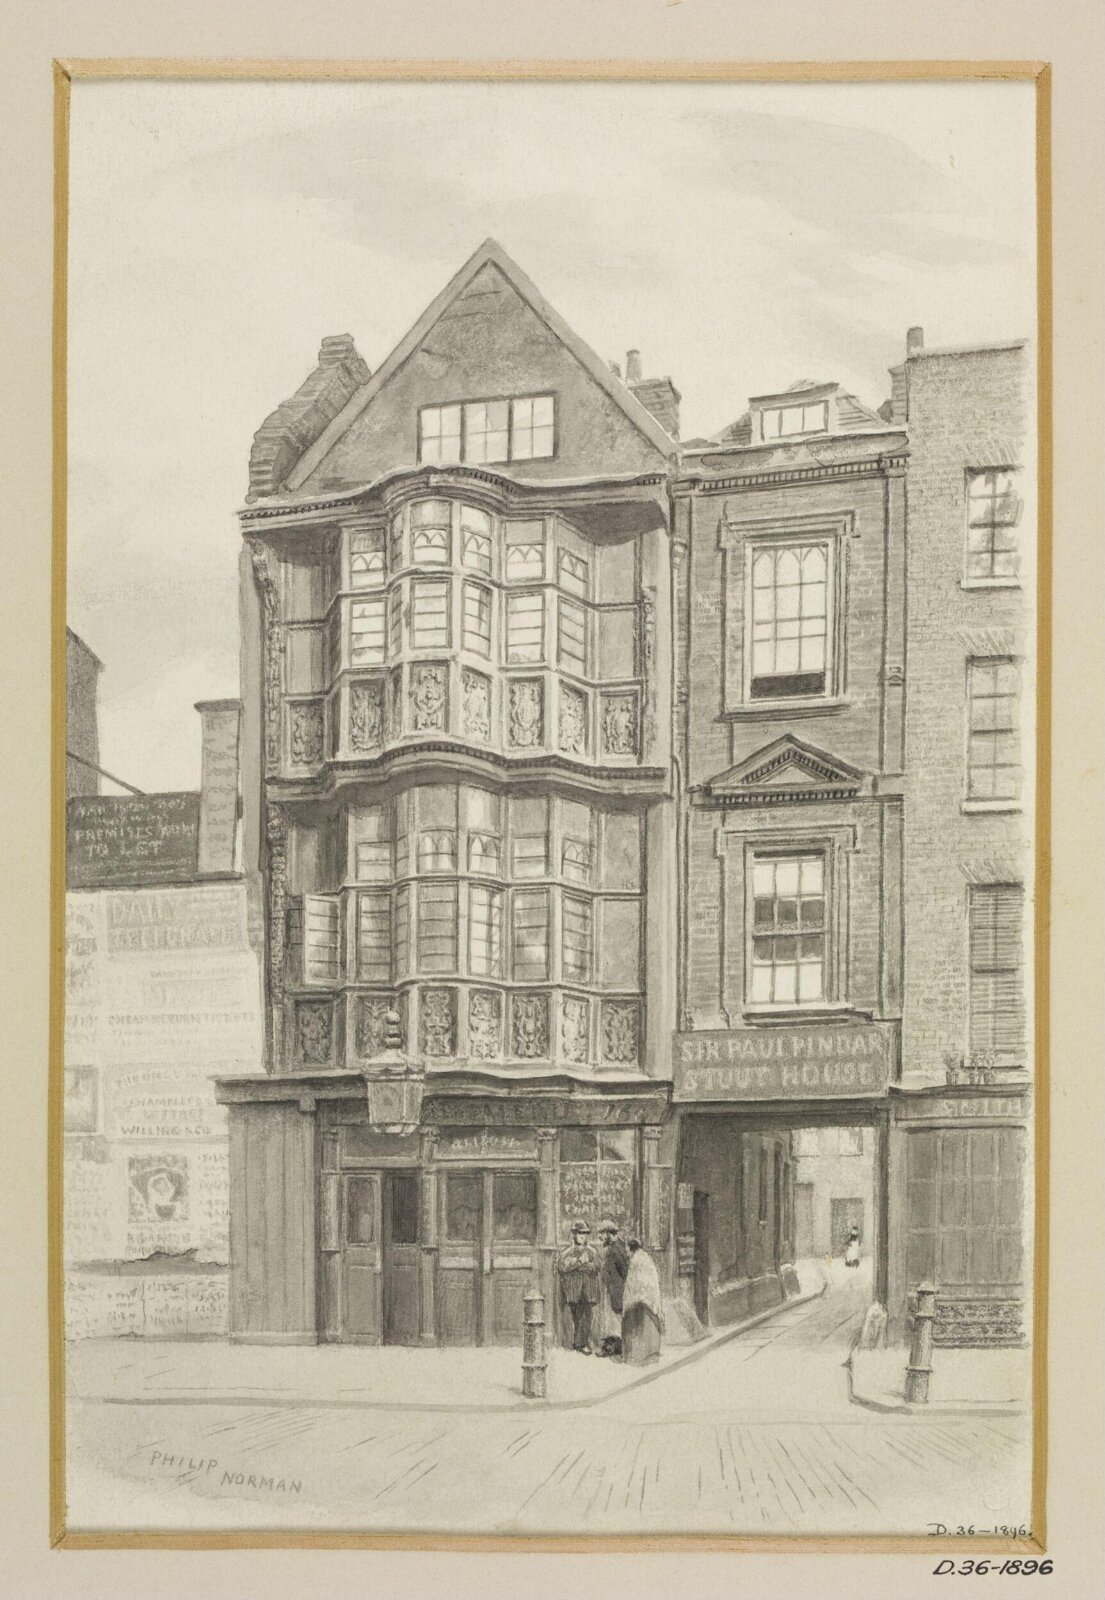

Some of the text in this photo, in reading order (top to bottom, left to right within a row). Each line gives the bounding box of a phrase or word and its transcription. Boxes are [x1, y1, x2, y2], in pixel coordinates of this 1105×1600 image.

[681, 1040, 719, 1062] SIR
[151, 1451, 218, 1474] PHILIP
[220, 1470, 303, 1494] NORMAN
[933, 1559, 1054, 1576] D.36-1896
